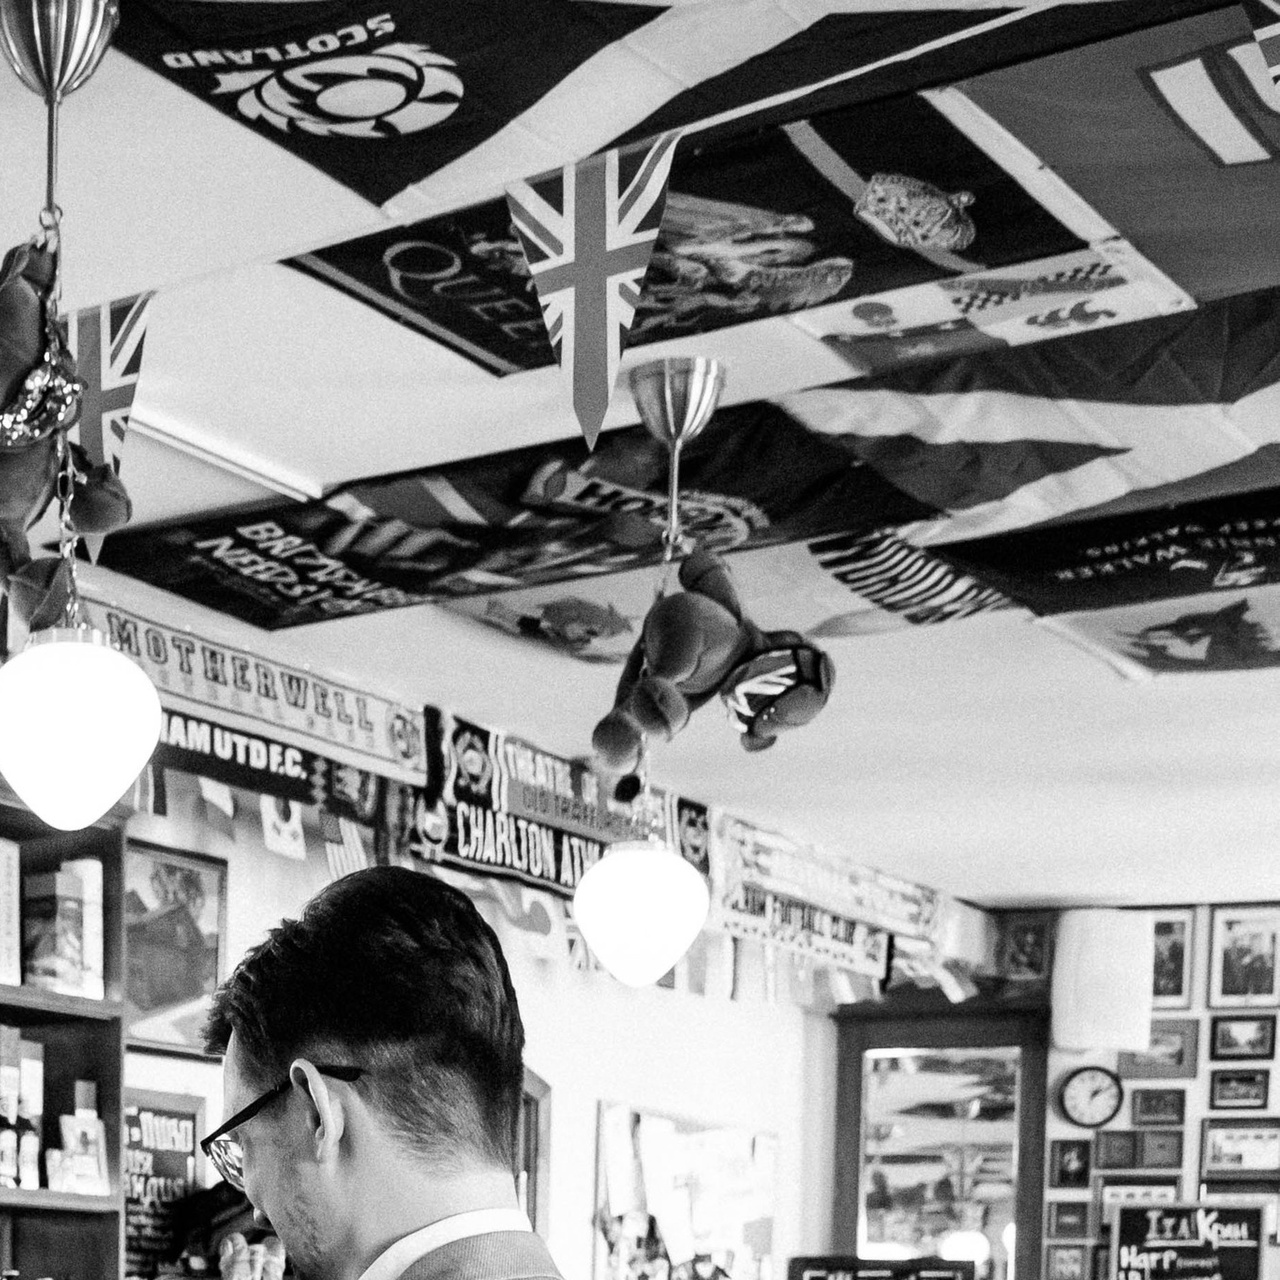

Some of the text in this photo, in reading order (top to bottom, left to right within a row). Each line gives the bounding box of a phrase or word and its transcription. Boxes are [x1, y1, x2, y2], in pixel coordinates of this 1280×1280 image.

[162, 13, 396, 68] SCOTLAND
[106, 610, 373, 734] MOTHERWELL
[456, 802, 556, 881] CHARLTON
